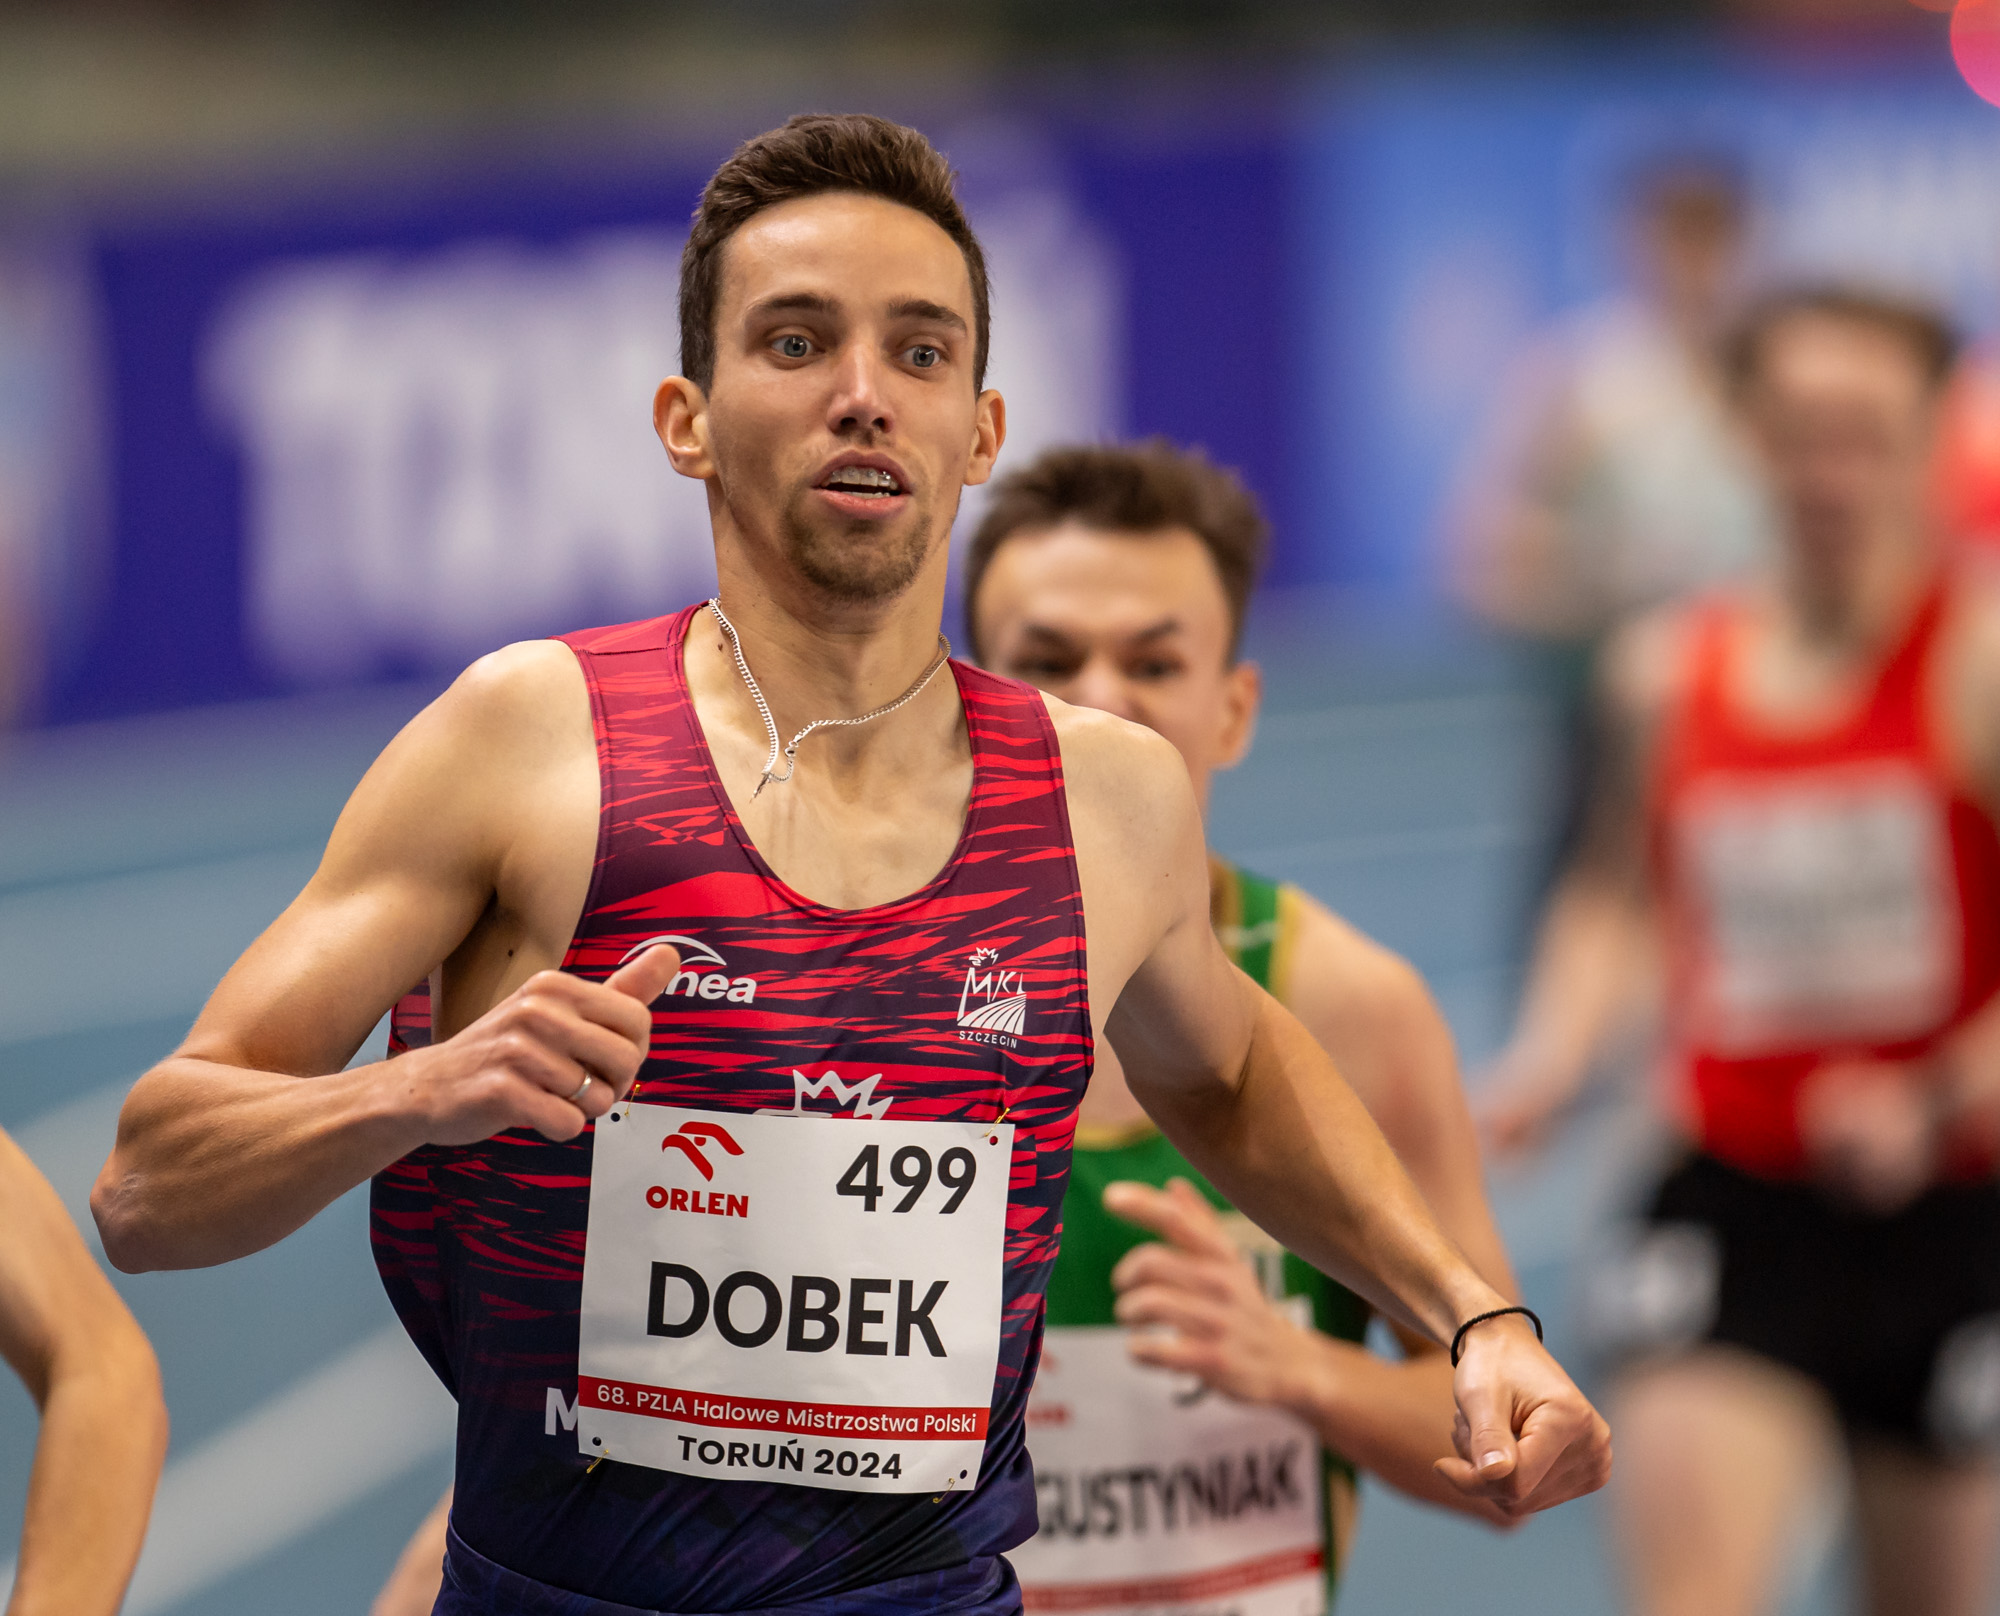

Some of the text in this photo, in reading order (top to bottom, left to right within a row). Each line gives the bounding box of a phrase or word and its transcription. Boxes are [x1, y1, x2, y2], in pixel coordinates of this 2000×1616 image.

[660, 970, 757, 1004] nea
[959, 1030, 1018, 1049] SZCZECIN
[836, 1144, 977, 1214] 499
[645, 1186, 749, 1218] ORLEN
[646, 1261, 950, 1358] DOBEK
[597, 1384, 977, 1433] 68. PZLA Halowe Mistrzostwa Polski
[677, 1435, 902, 1479] TORUŃ 2024
